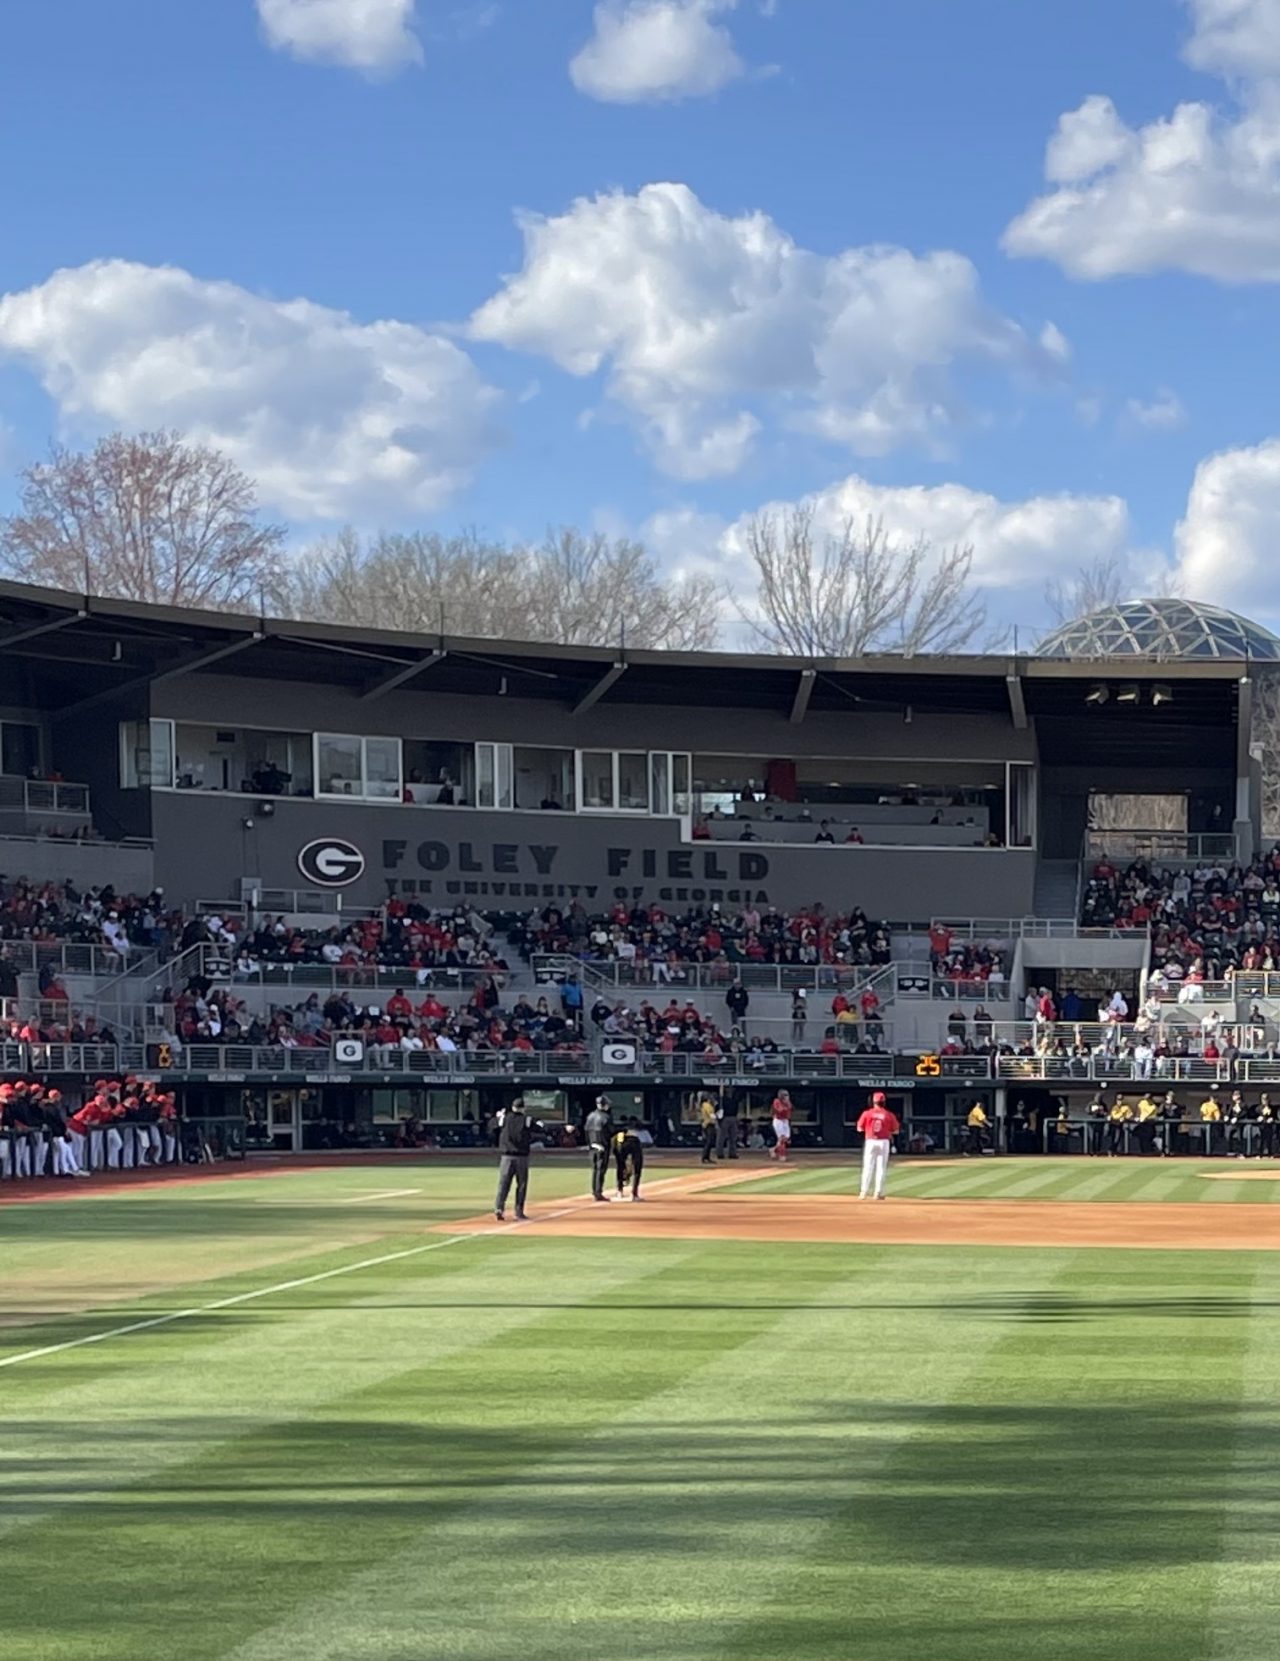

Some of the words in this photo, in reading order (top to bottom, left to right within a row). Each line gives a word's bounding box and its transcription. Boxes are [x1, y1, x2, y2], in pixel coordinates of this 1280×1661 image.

[298, 837, 365, 886] G
[382, 839, 559, 874] FOLEY
[607, 848, 769, 881] FIELD
[385, 878, 432, 894] THE
[446, 880, 598, 898] UNIVERSITY
[613, 886, 644, 900] OF
[659, 887, 769, 904] GEORGIA
[916, 1055, 940, 1075] 25
[857, 1079, 886, 1087] WELLS
